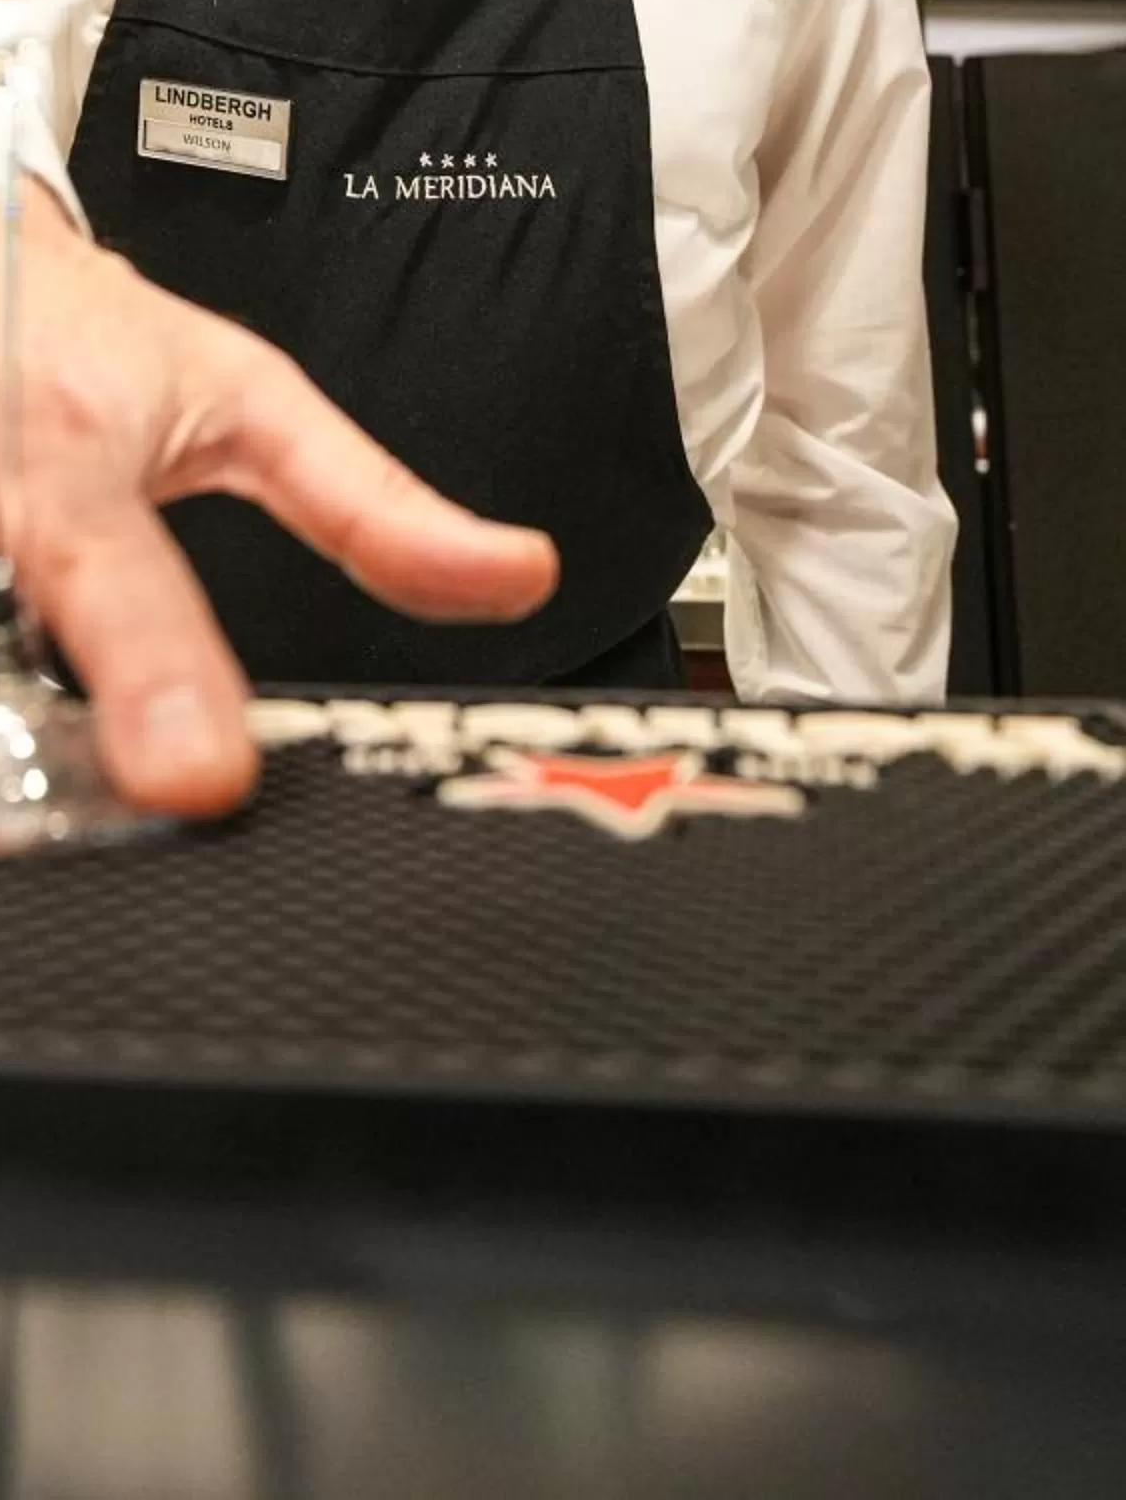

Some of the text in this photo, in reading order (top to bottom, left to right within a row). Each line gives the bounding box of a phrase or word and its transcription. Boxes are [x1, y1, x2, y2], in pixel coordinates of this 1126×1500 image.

[154, 85, 272, 121] LINDBERGH
[189, 114, 234, 131] HOTELS
[182, 133, 232, 153] WILSON
[344, 173, 556, 200] LA MERIDIANA
